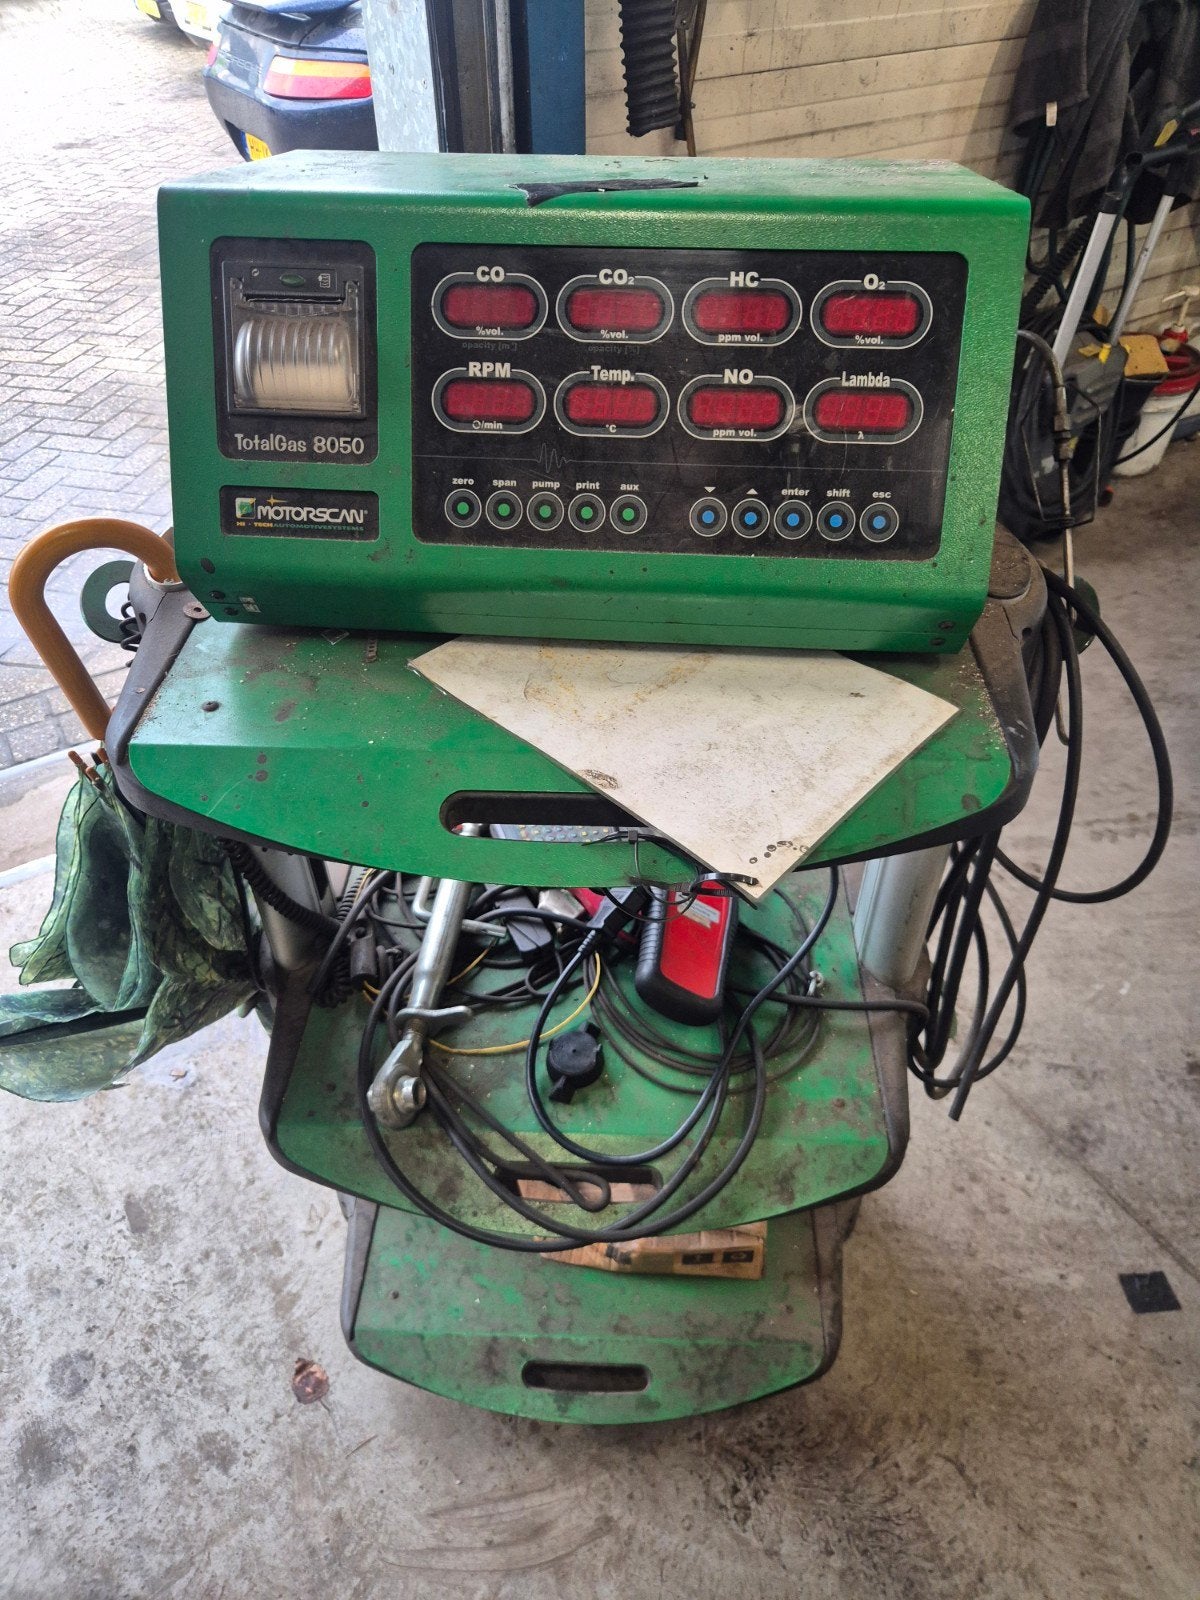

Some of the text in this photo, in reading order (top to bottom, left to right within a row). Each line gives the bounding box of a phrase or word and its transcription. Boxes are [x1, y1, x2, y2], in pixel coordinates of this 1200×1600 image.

[476, 265, 505, 283] CO
[729, 271, 759, 288] HC
[718, 333, 764, 343] ppm vol.
[468, 361, 511, 378] RPM
[590, 365, 635, 385] Temp.
[723, 368, 754, 385] NO
[841, 371, 891, 387] Lambda
[713, 428, 757, 437] ppm vol.
[234, 433, 365, 455] TotalGas 8050
[452, 477, 474, 485] zero
[492, 479, 517, 488] span
[532, 480, 560, 490] pump
[575, 481, 600, 491] print
[620, 483, 639, 491] aux
[781, 488, 810, 497] enter
[826, 488, 850, 498] shift
[872, 491, 892, 499] esc
